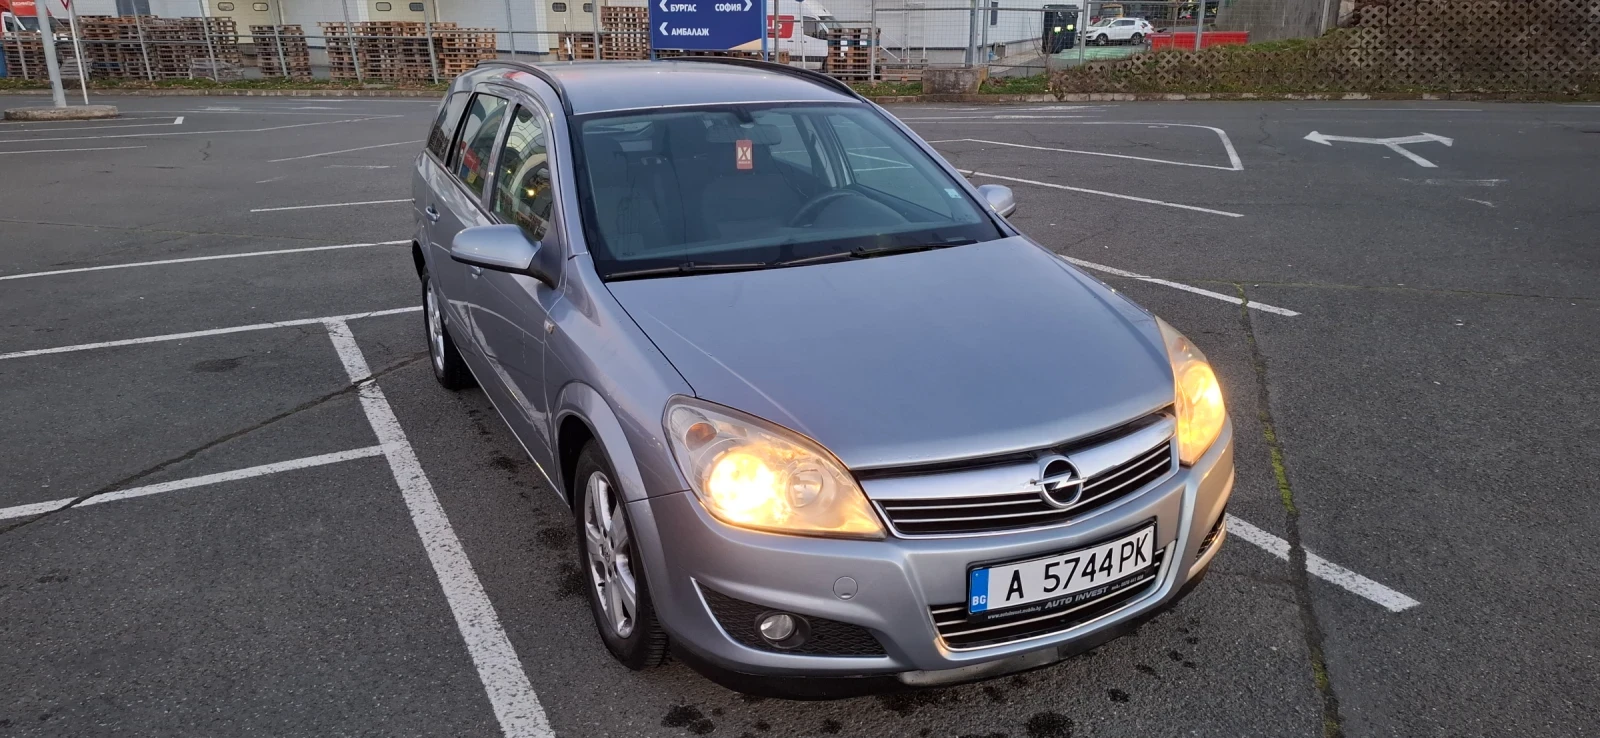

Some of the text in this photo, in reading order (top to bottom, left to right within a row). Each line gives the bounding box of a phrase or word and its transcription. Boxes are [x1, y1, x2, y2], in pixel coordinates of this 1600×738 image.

[670, 4, 697, 12] БУРГАС
[715, 3, 742, 12] СОФИЯ
[671, 28, 710, 36] АМБАЛАЖ
[1005, 569, 1025, 602] A
[972, 594, 987, 606] BG
[1044, 597, 1073, 609] AUTO
[1074, 585, 1110, 602] INVEST
